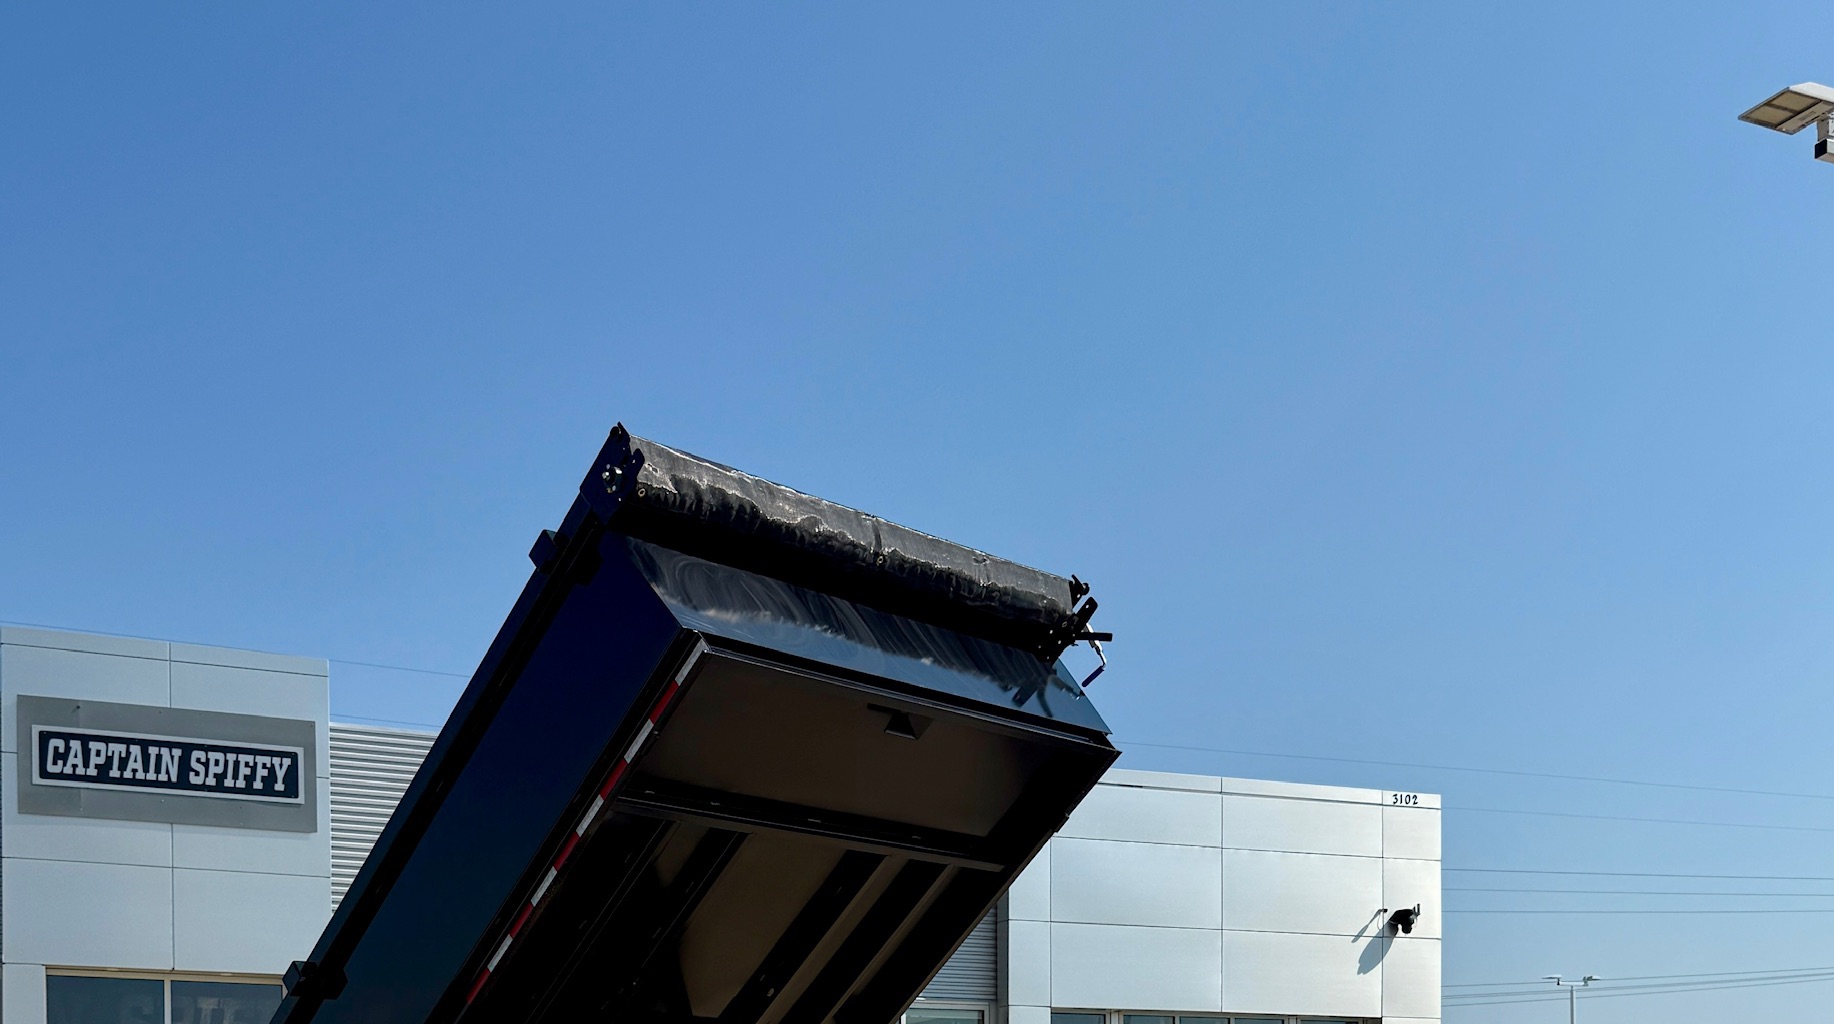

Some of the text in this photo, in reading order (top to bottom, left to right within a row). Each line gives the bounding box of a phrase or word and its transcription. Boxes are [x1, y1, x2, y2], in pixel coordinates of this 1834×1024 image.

[46, 738, 292, 792] CAPTAIN SPIFFY
[1392, 793, 1418, 805] 3102
